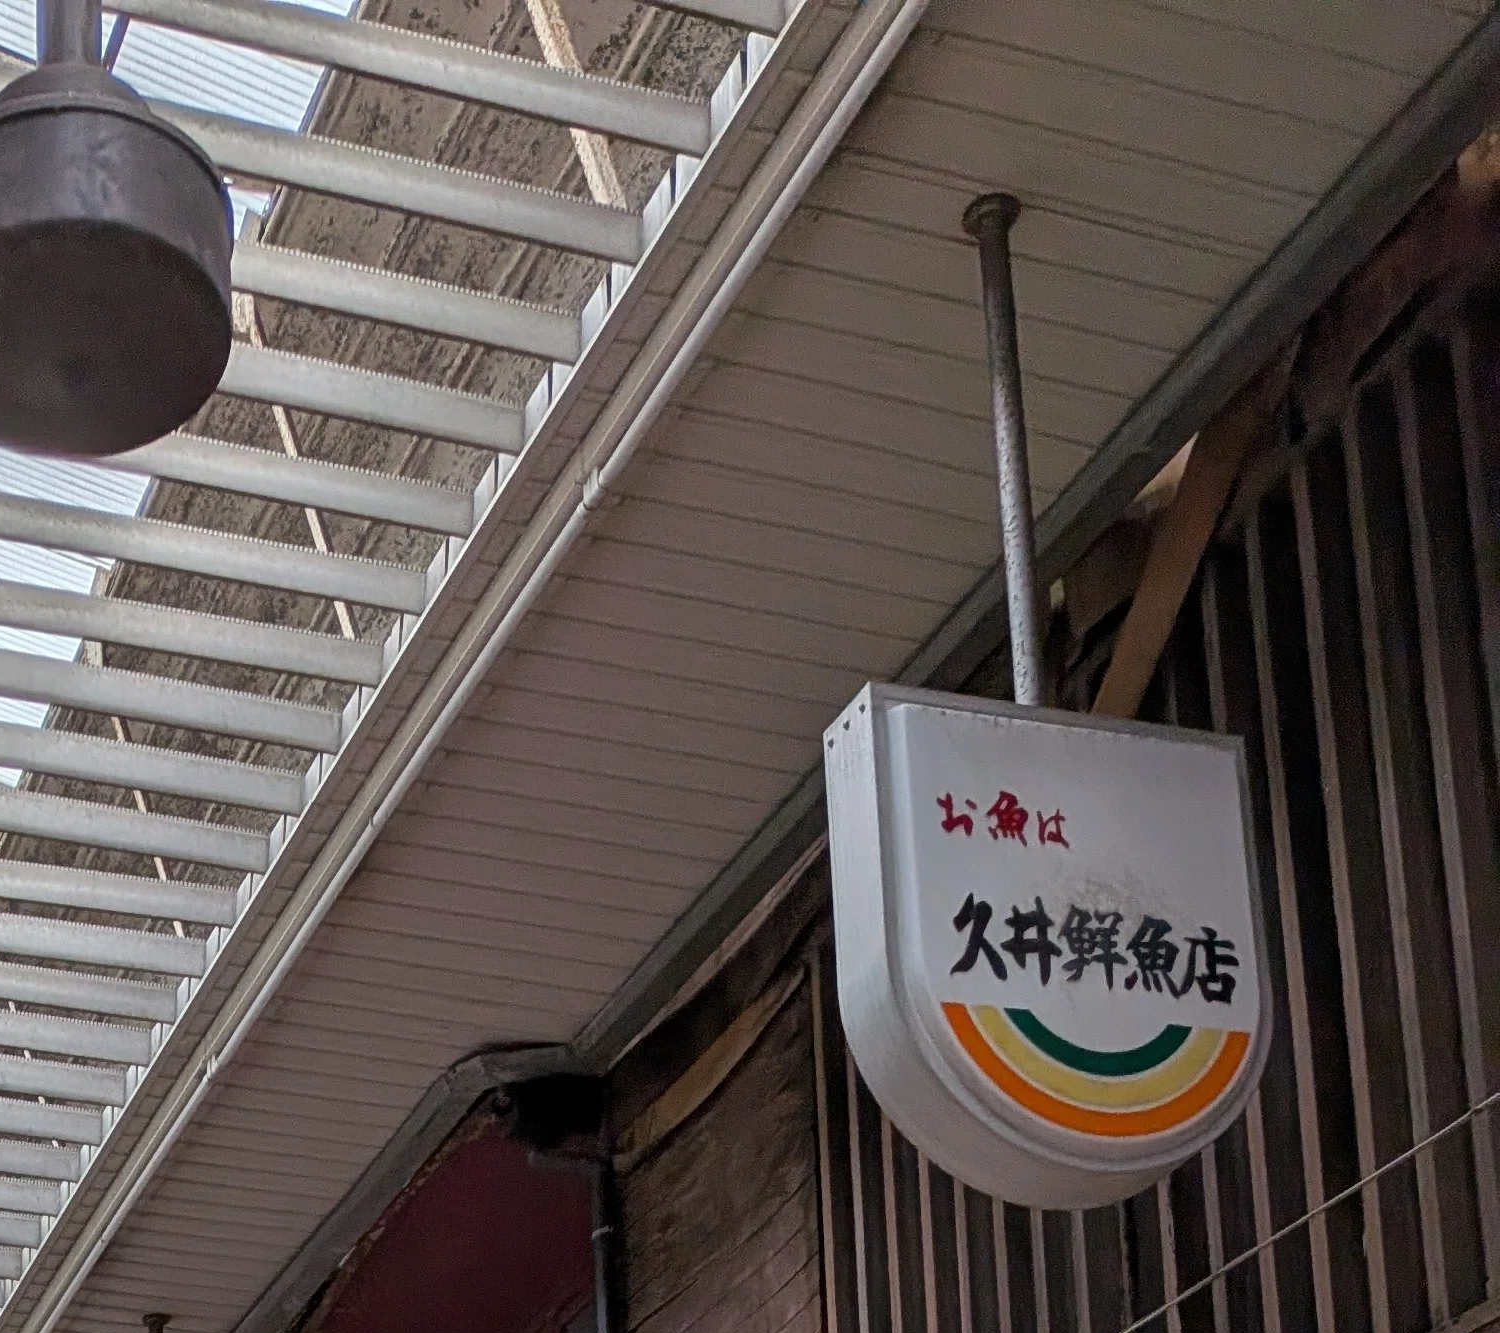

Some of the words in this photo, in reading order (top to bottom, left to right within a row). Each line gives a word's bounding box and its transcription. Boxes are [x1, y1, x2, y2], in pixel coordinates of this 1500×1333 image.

[936, 790, 1071, 849] お魚は
[950, 891, 1240, 1004] 久井鮮魚店
